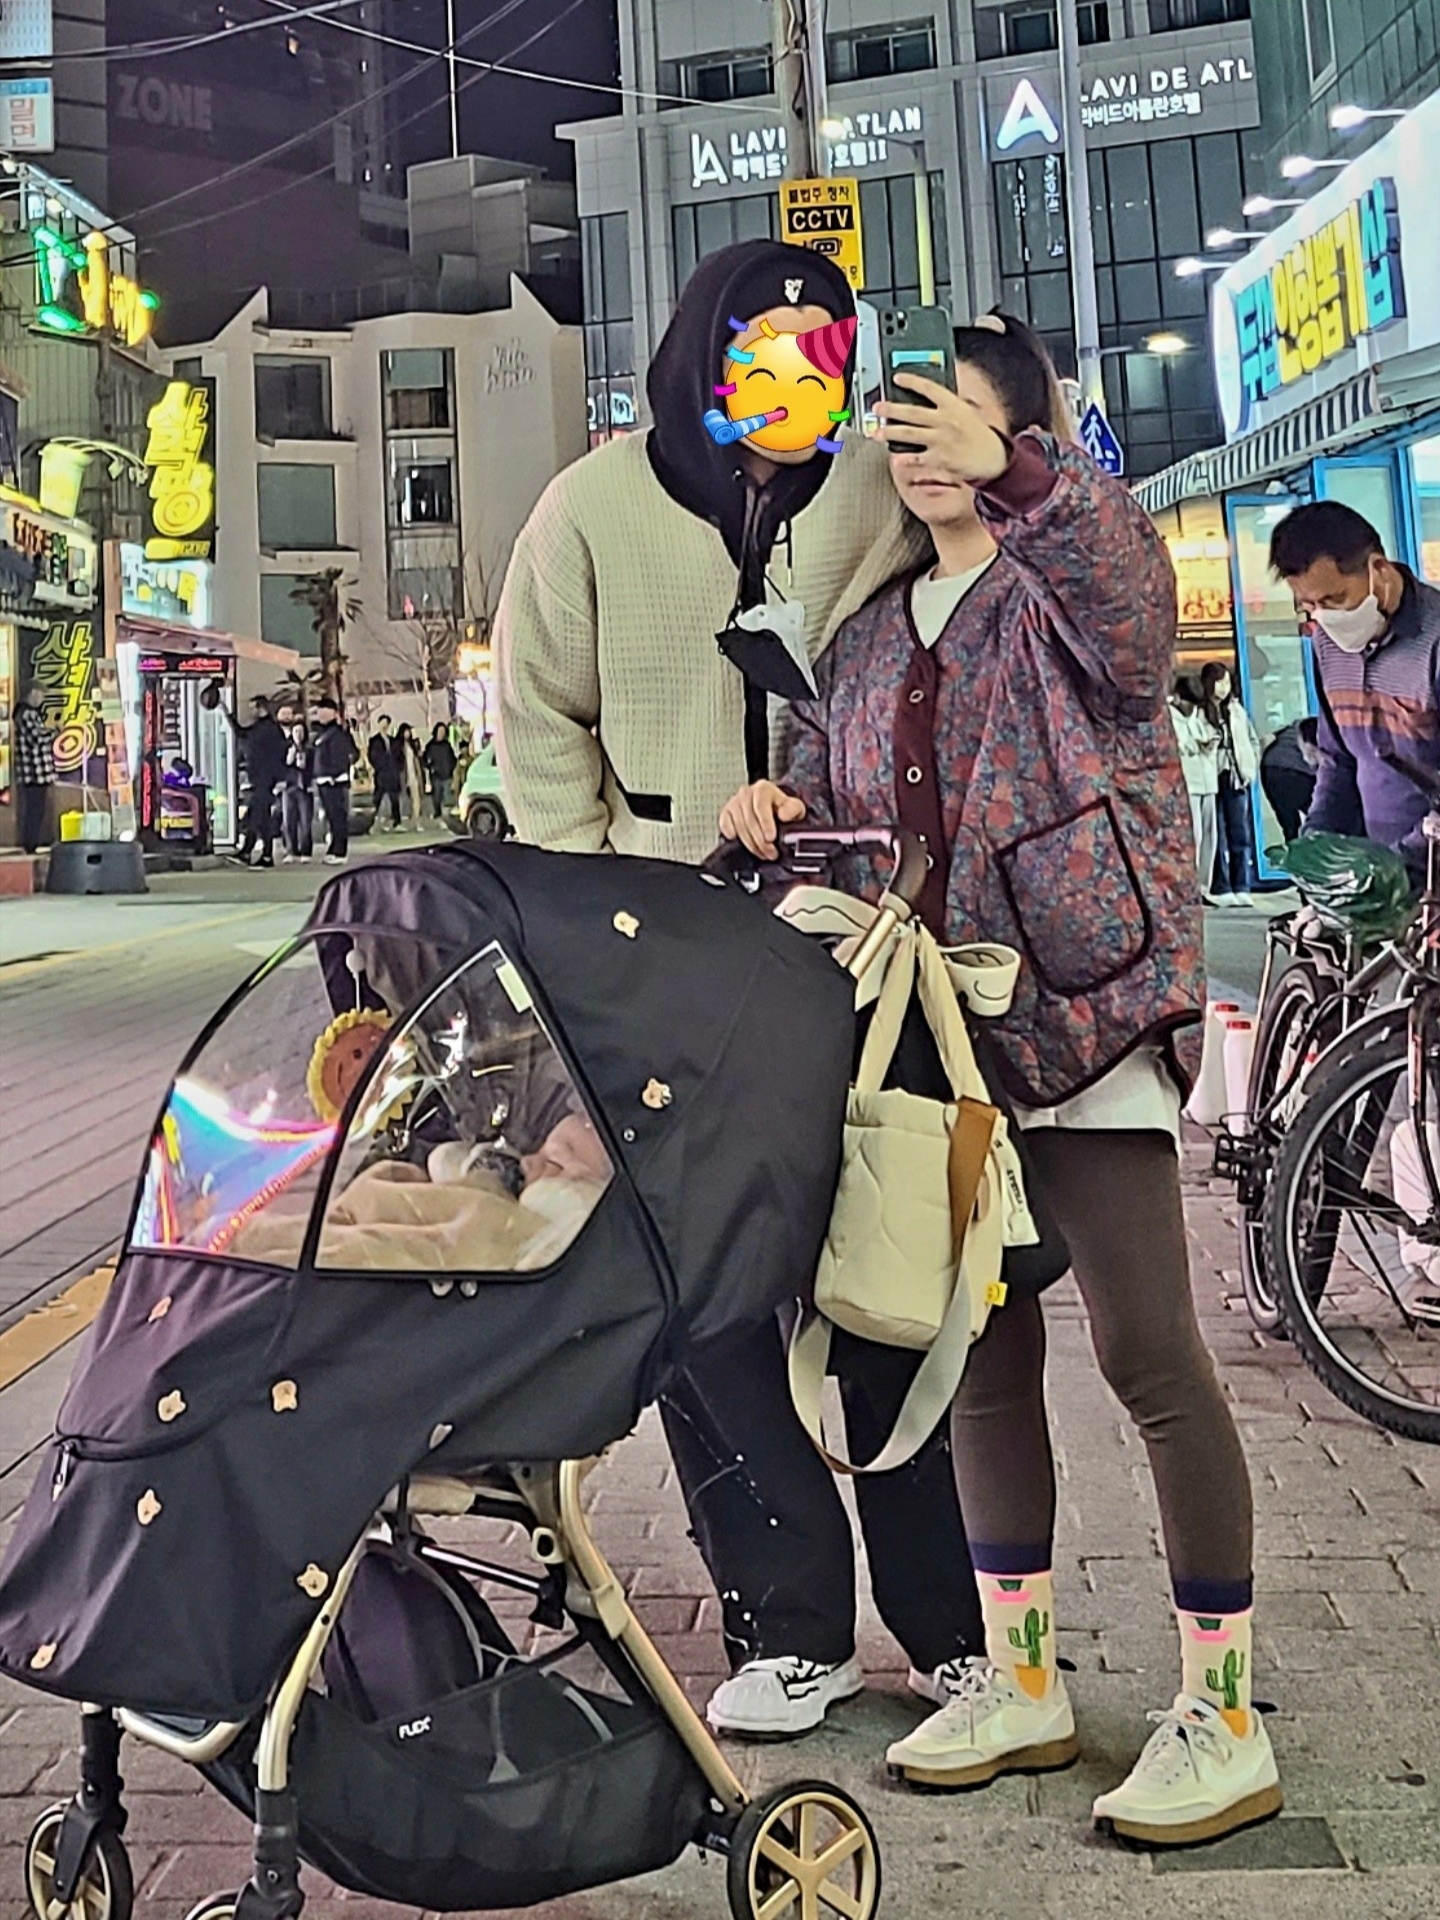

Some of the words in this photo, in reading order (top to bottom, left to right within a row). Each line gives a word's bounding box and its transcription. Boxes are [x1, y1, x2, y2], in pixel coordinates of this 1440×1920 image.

[1150, 66, 1189, 93] DE
[1200, 58, 1253, 86] ATL
[115, 74, 212, 131] ZONE
[730, 126, 787, 156] LAVI
[792, 208, 849, 231] CCTV
